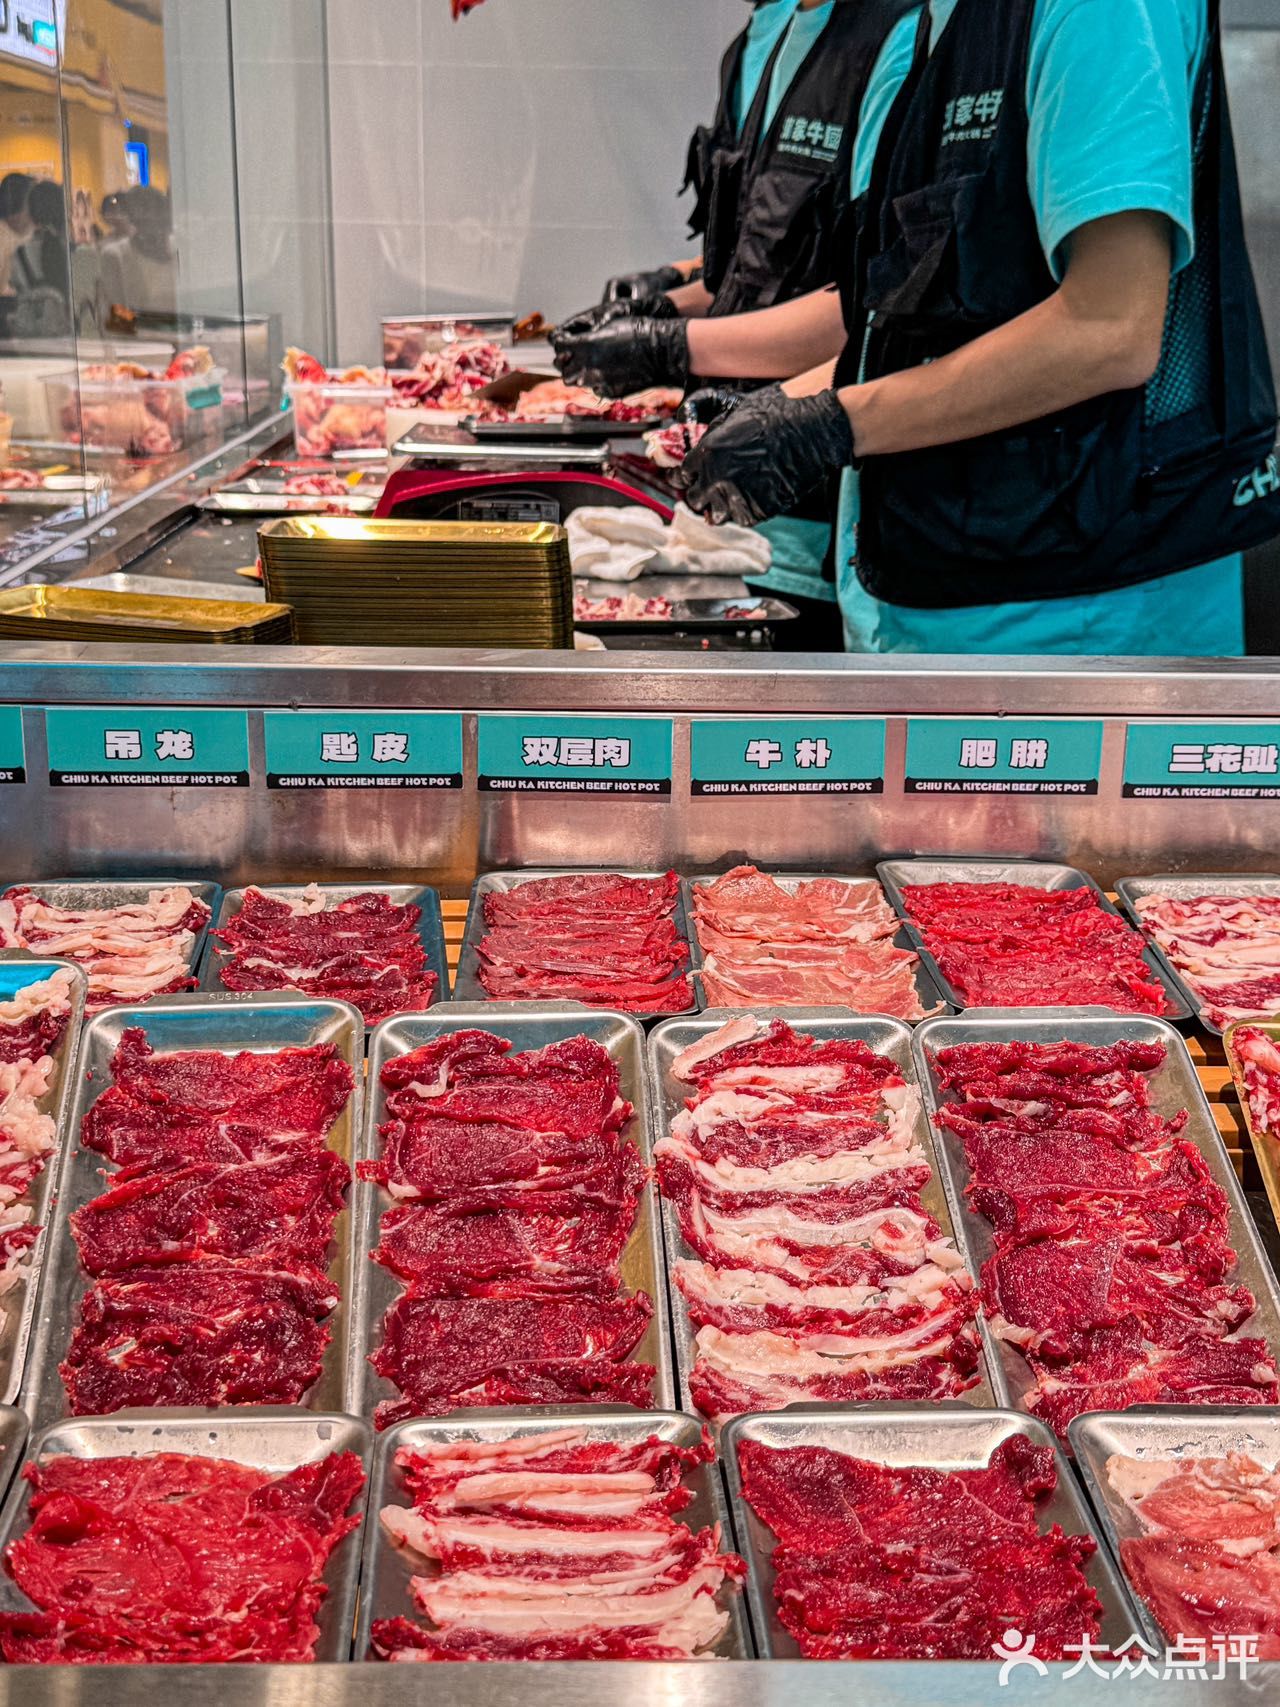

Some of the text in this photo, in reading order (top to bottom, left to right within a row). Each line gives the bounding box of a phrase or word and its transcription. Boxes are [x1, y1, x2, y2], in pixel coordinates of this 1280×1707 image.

[104, 729, 195, 761] 吊龙
[320, 733, 409, 762] 匙皮
[522, 737, 631, 767] 双层肉
[745, 739, 832, 768] 牛朴
[1169, 744, 1278, 774] 三花趾
[61, 774, 238, 784] CHIU KA KITCHEN BEEF HOT POT
[279, 777, 452, 787] CHIU KA KITCHEN BEEF HOT POT
[490, 780, 660, 791] CHIU KA KITCHEN BEEF HOT POT
[702, 783, 872, 793] CHIU KA KITCHEN BEEF HOT POT
[915, 782, 1087, 791] CHIU KA KITCHEN BEEF HOT POT
[1133, 787, 1161, 796] CHIU
[1162, 787, 1180, 796] KA
[1181, 787, 1230, 796] KITCHEN
[1231, 787, 1259, 796] BEEF
[208, 992, 253, 1001] SUS 304
